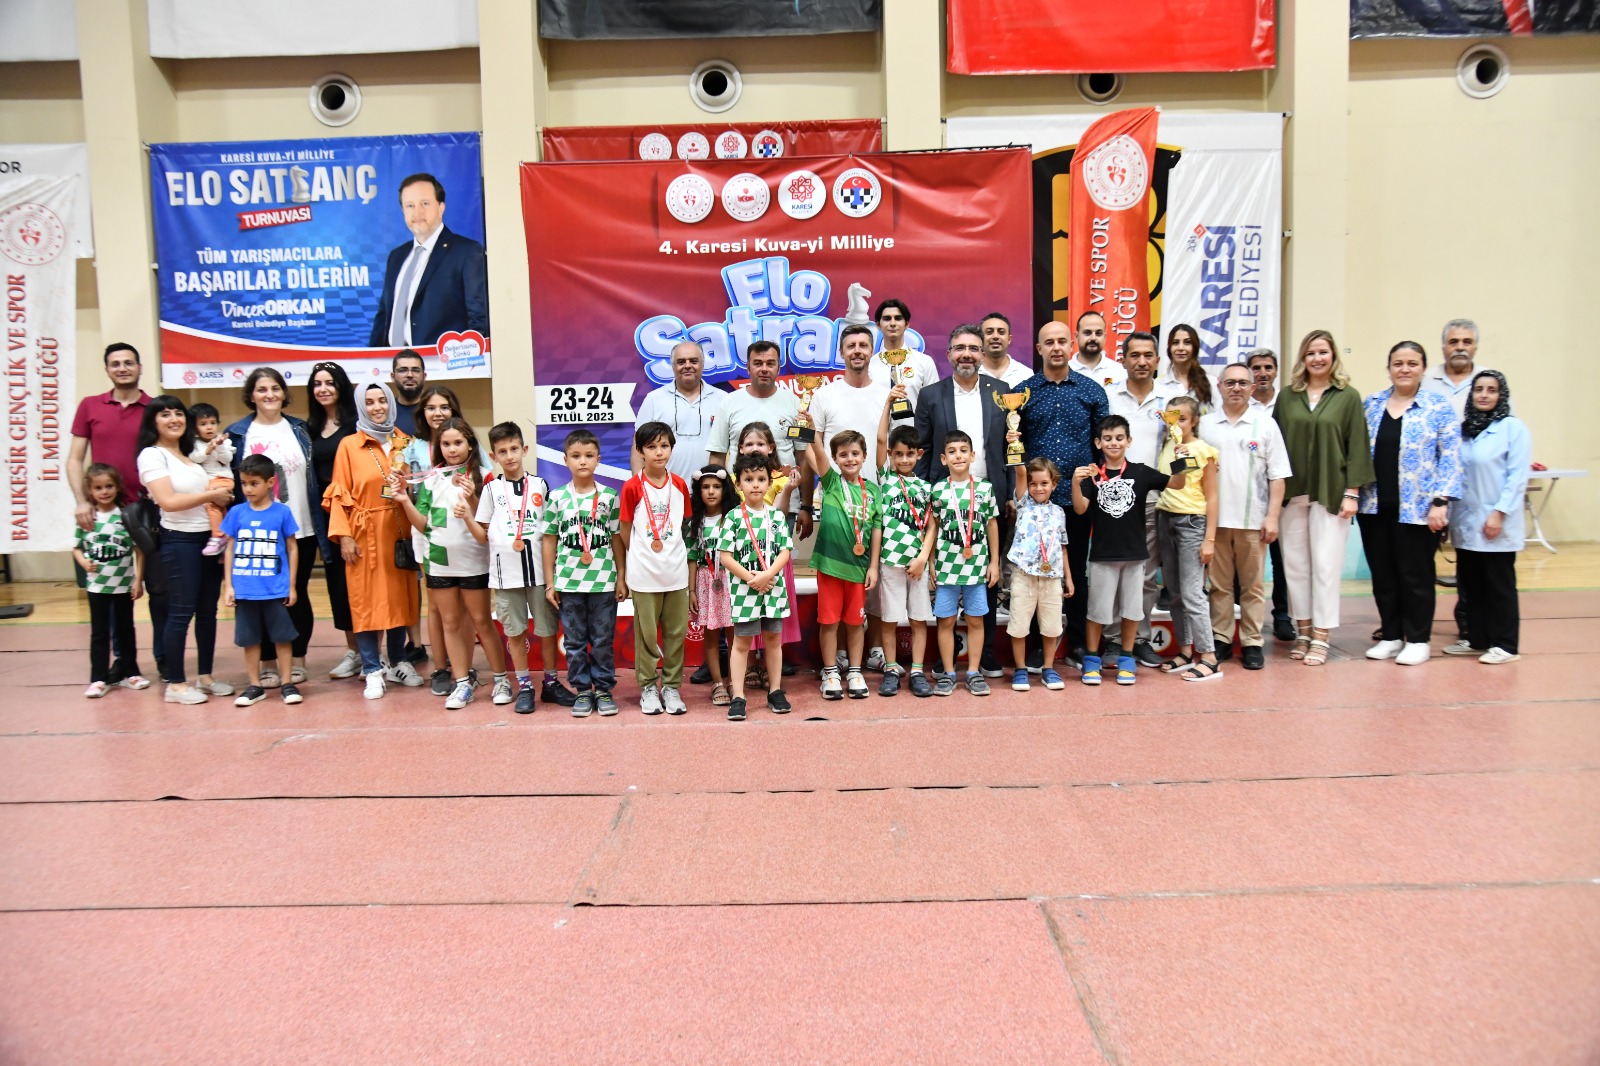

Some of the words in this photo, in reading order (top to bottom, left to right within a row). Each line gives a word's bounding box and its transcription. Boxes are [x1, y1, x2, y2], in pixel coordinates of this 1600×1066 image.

[221, 151, 255, 163] KARESİ
[257, 149, 295, 162] KUVA-Yİ
[297, 148, 335, 160] MİLLİYE
[165, 170, 222, 207] ELO
[229, 164, 378, 205] SATANÇ
[242, 206, 311, 228] TURNUVASI
[196, 247, 227, 264] TÜM
[230, 246, 343, 266] YARIŞMACILARA
[659, 240, 679, 255] 4.
[686, 238, 747, 254] Karesi
[754, 236, 823, 253] Kuva-yi
[831, 234, 895, 250] Milliye
[1091, 216, 1110, 273] SPOR
[174, 269, 281, 297] BAŞARILAR
[287, 262, 370, 289] DİLERİM
[721, 256, 831, 316] Elo
[1089, 278, 1106, 306] VE
[7, 274, 26, 323] SPOR
[8, 328, 27, 351] VE
[3, 357, 31, 441] GENÇLİK
[36, 337, 60, 459] MÜDÜRLÜĞÜ
[550, 387, 614, 411] 23-24
[551, 411, 583, 422] EYLÜL
[586, 412, 614, 422] 2023
[37, 464, 60, 481] İL
[5, 446, 29, 541] BALIKESİR
[1153, 630, 1164, 647] 4
